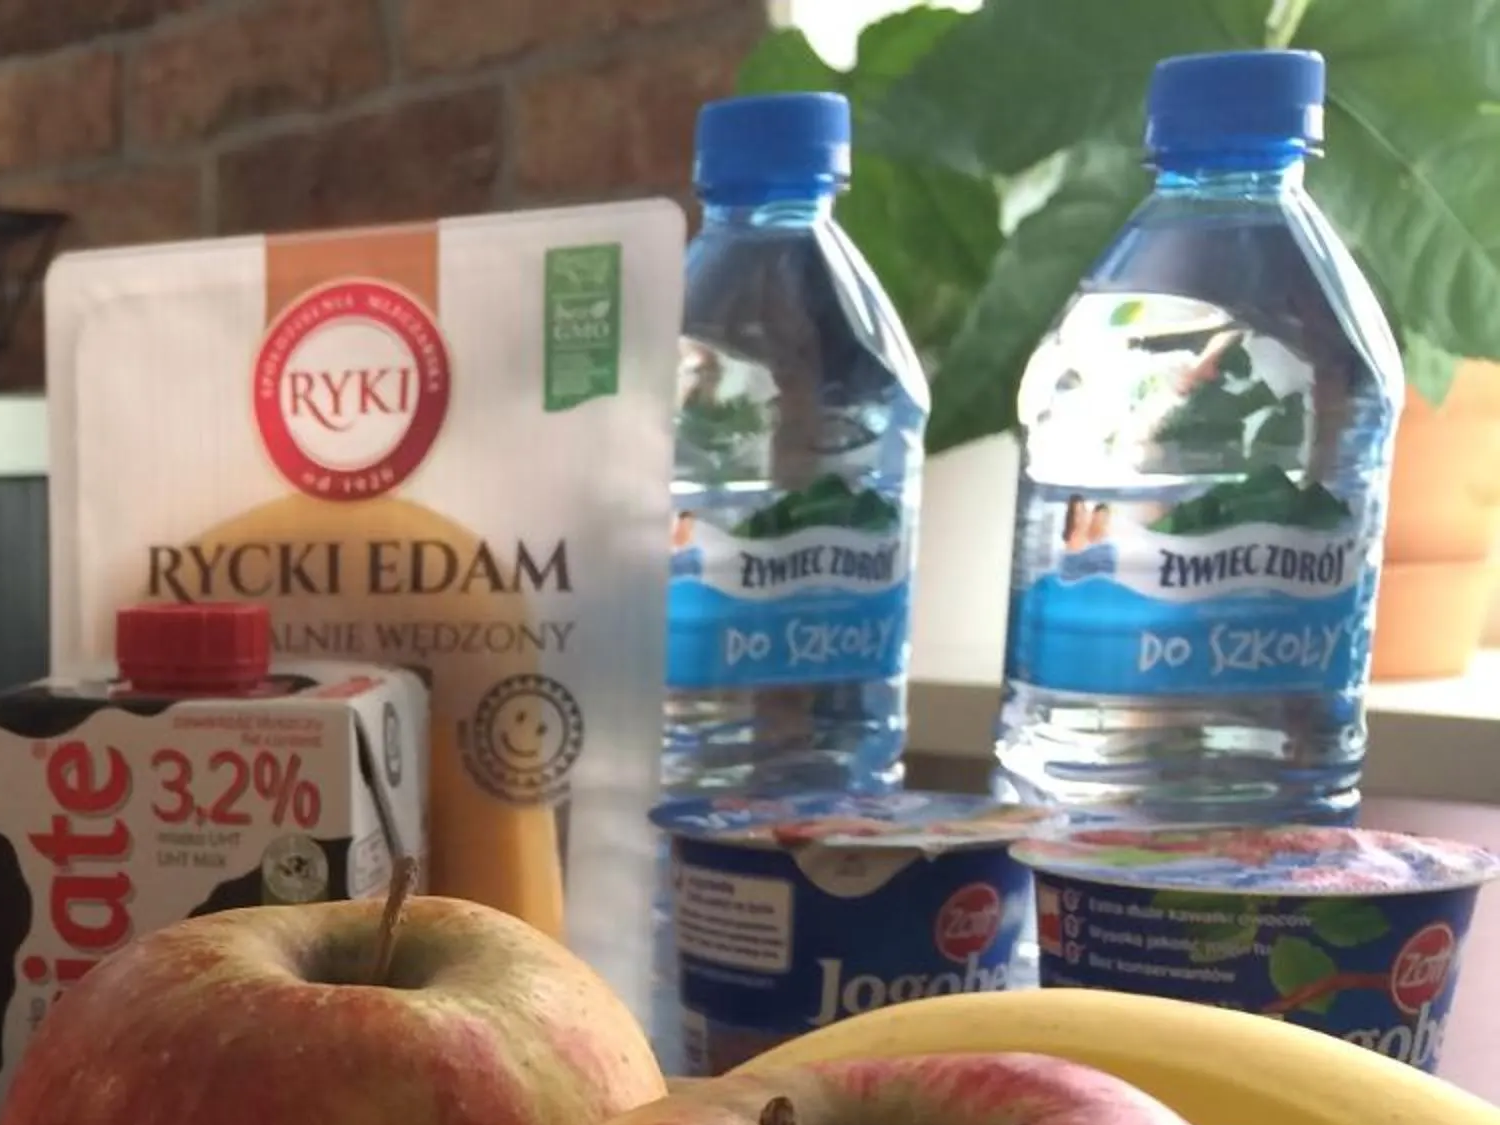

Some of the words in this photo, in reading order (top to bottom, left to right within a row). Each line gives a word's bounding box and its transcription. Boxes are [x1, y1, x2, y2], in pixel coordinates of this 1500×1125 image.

[288, 367, 412, 432] RYKI
[147, 540, 342, 604] RYCKI
[367, 537, 574, 597] EDAM
[1158, 543, 1260, 588] ŻYWIEC
[1264, 545, 1347, 587] ZDRÓJ
[372, 619, 577, 659] WĘDZONY
[724, 627, 772, 666] DO
[1137, 632, 1192, 673] DO
[1208, 622, 1346, 676] SZKOŁY
[22, 740, 134, 1002] iate
